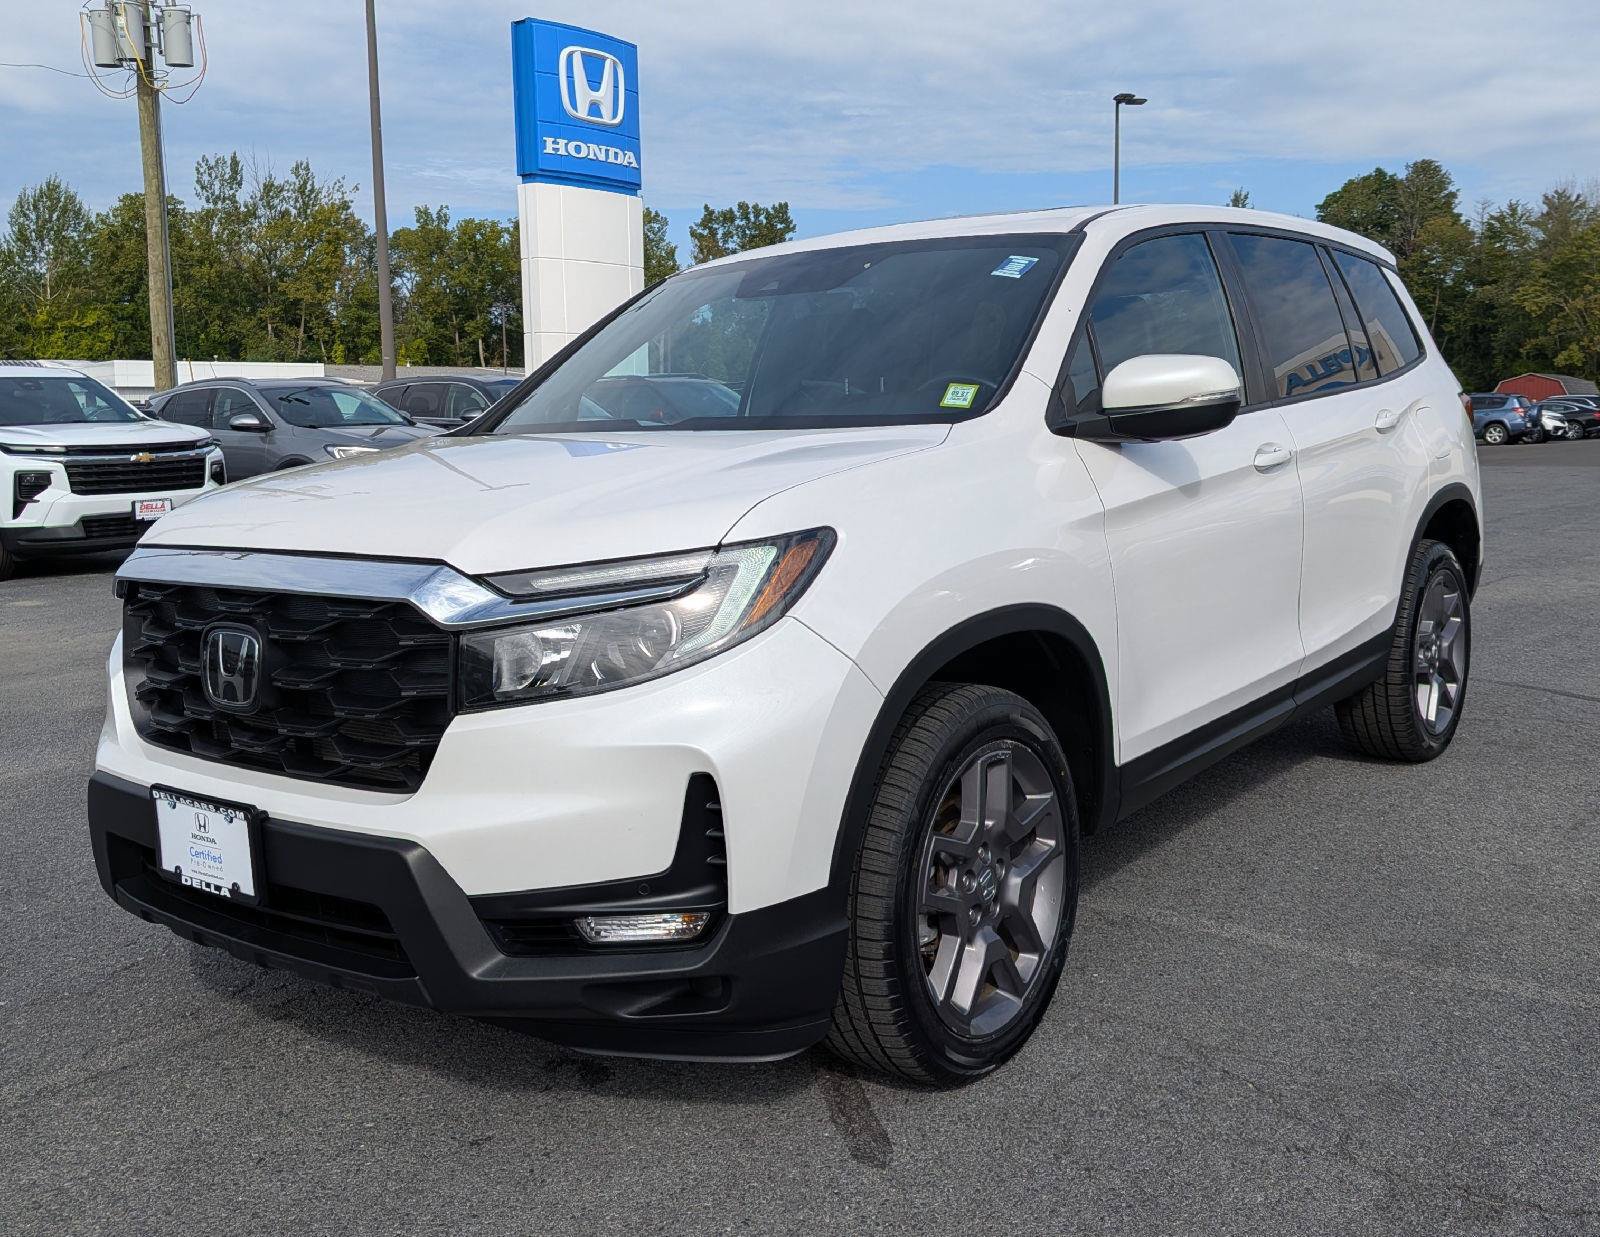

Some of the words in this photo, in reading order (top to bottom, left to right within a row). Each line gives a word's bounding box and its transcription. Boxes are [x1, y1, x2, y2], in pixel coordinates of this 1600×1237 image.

[543, 136, 639, 168] HONDA
[140, 502, 166, 510] DELLA
[152, 790, 245, 820] DELLACARS.COM
[191, 832, 217, 845] HONDA
[189, 846, 223, 864] Certified
[181, 875, 231, 898] DELLA
